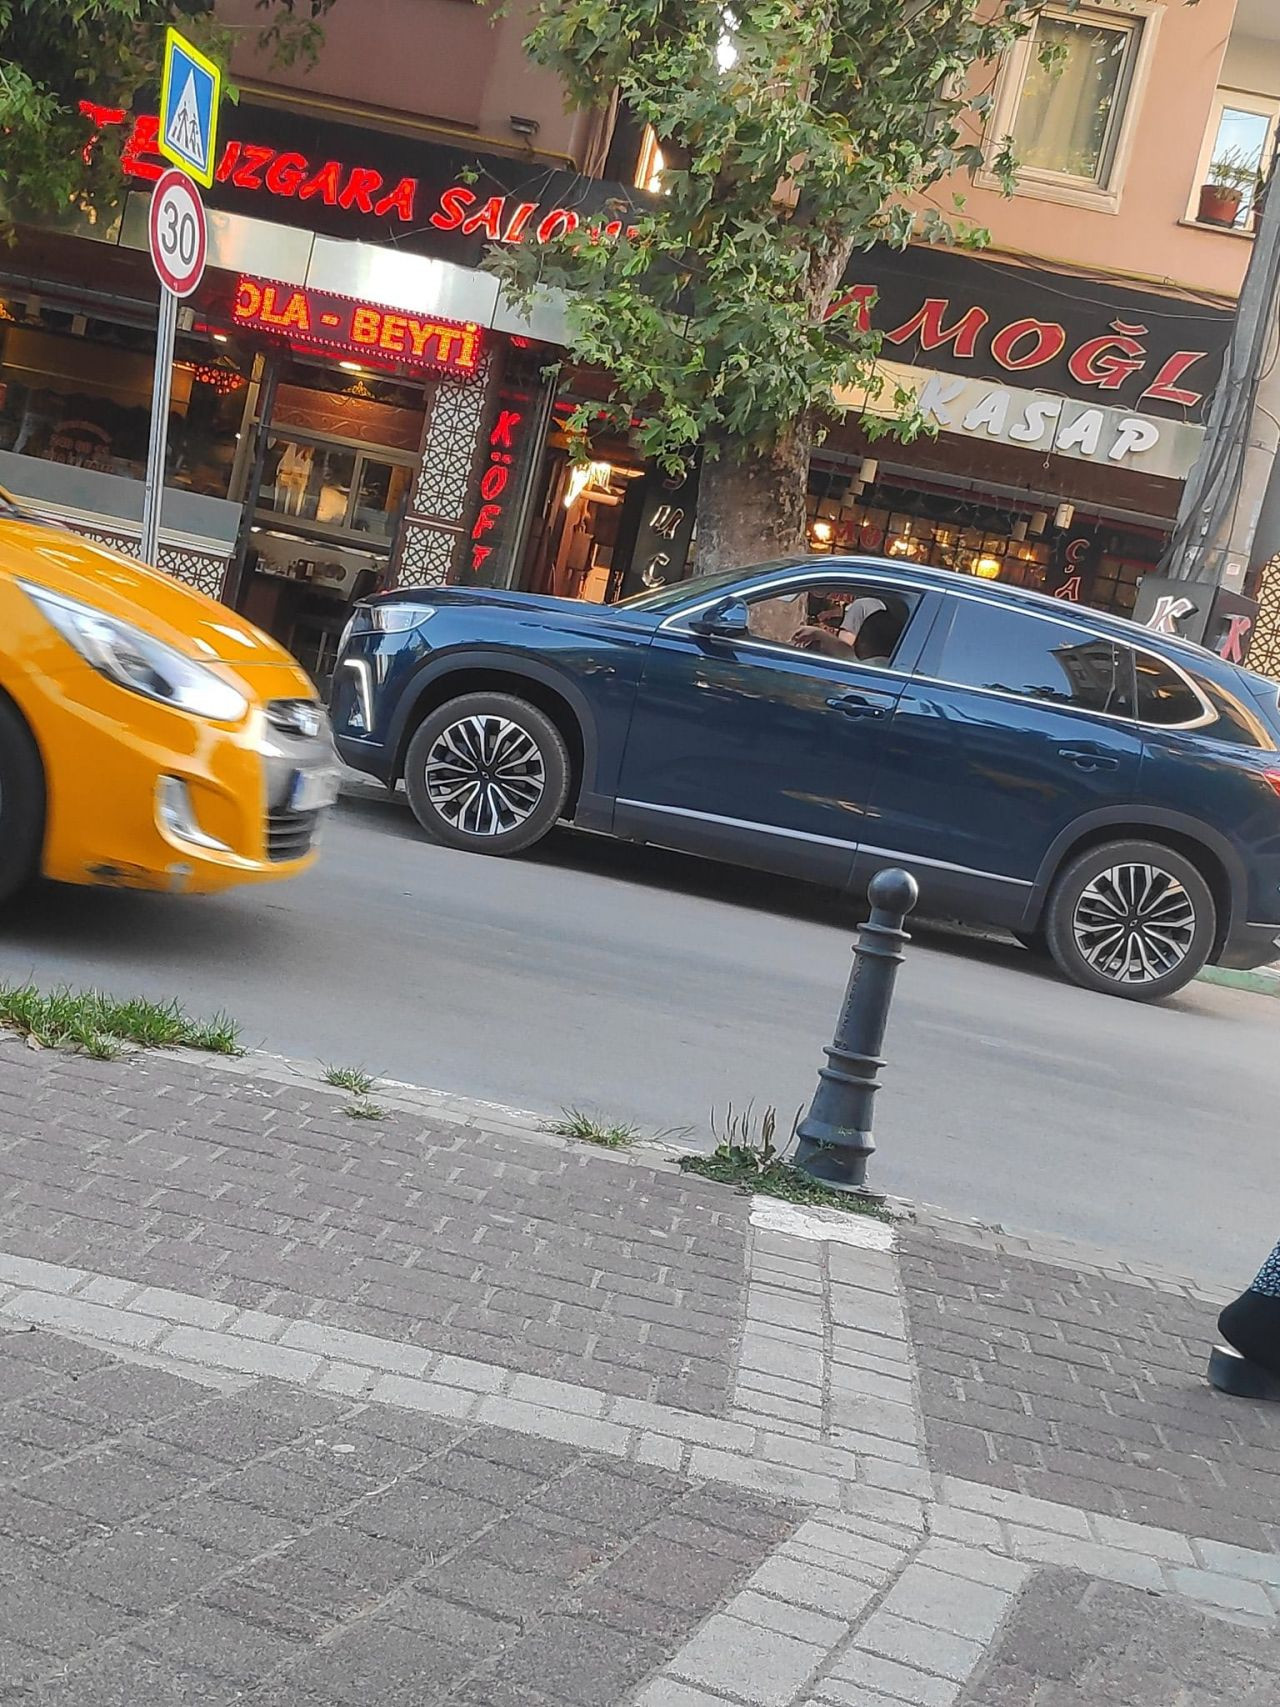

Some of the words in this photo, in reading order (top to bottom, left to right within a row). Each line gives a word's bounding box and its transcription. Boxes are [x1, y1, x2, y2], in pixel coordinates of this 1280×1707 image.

[162, 201, 195, 265] 30
[215, 141, 417, 221] IZGARA
[429, 187, 640, 250] SALO
[351, 305, 477, 368] BEYTİ
[919, 374, 1160, 462] KASAP
